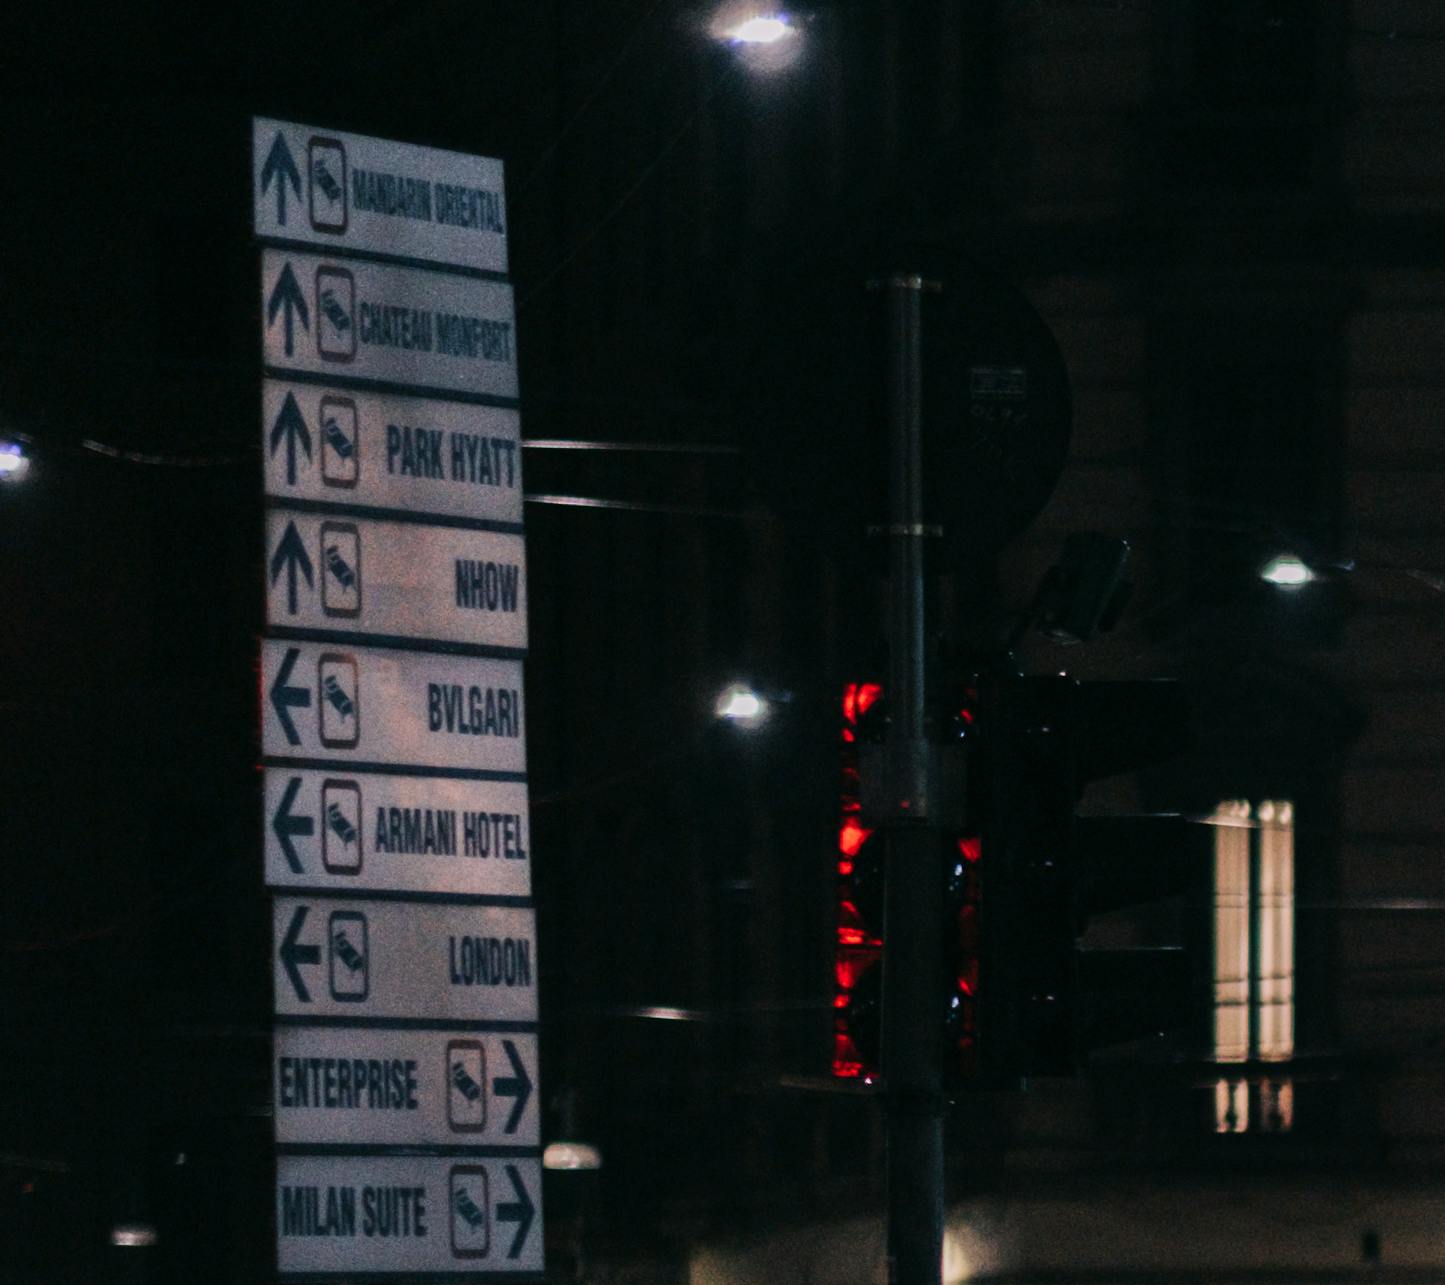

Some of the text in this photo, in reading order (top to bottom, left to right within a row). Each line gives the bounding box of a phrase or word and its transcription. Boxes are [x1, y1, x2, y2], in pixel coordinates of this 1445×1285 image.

[353, 168, 505, 234] MANDARIN ORIENTAL
[360, 302, 511, 366] CHATEAU MONFORT
[387, 425, 516, 488] PARK HYATT
[456, 559, 519, 612] NHOW
[428, 682, 519, 738] BVLGARI
[376, 807, 526, 860] ARMANI HOTEL
[449, 935, 530, 986] LONDON
[280, 1056, 418, 1110] ENTERPRISE
[281, 1186, 428, 1237] MILAN SUITE
